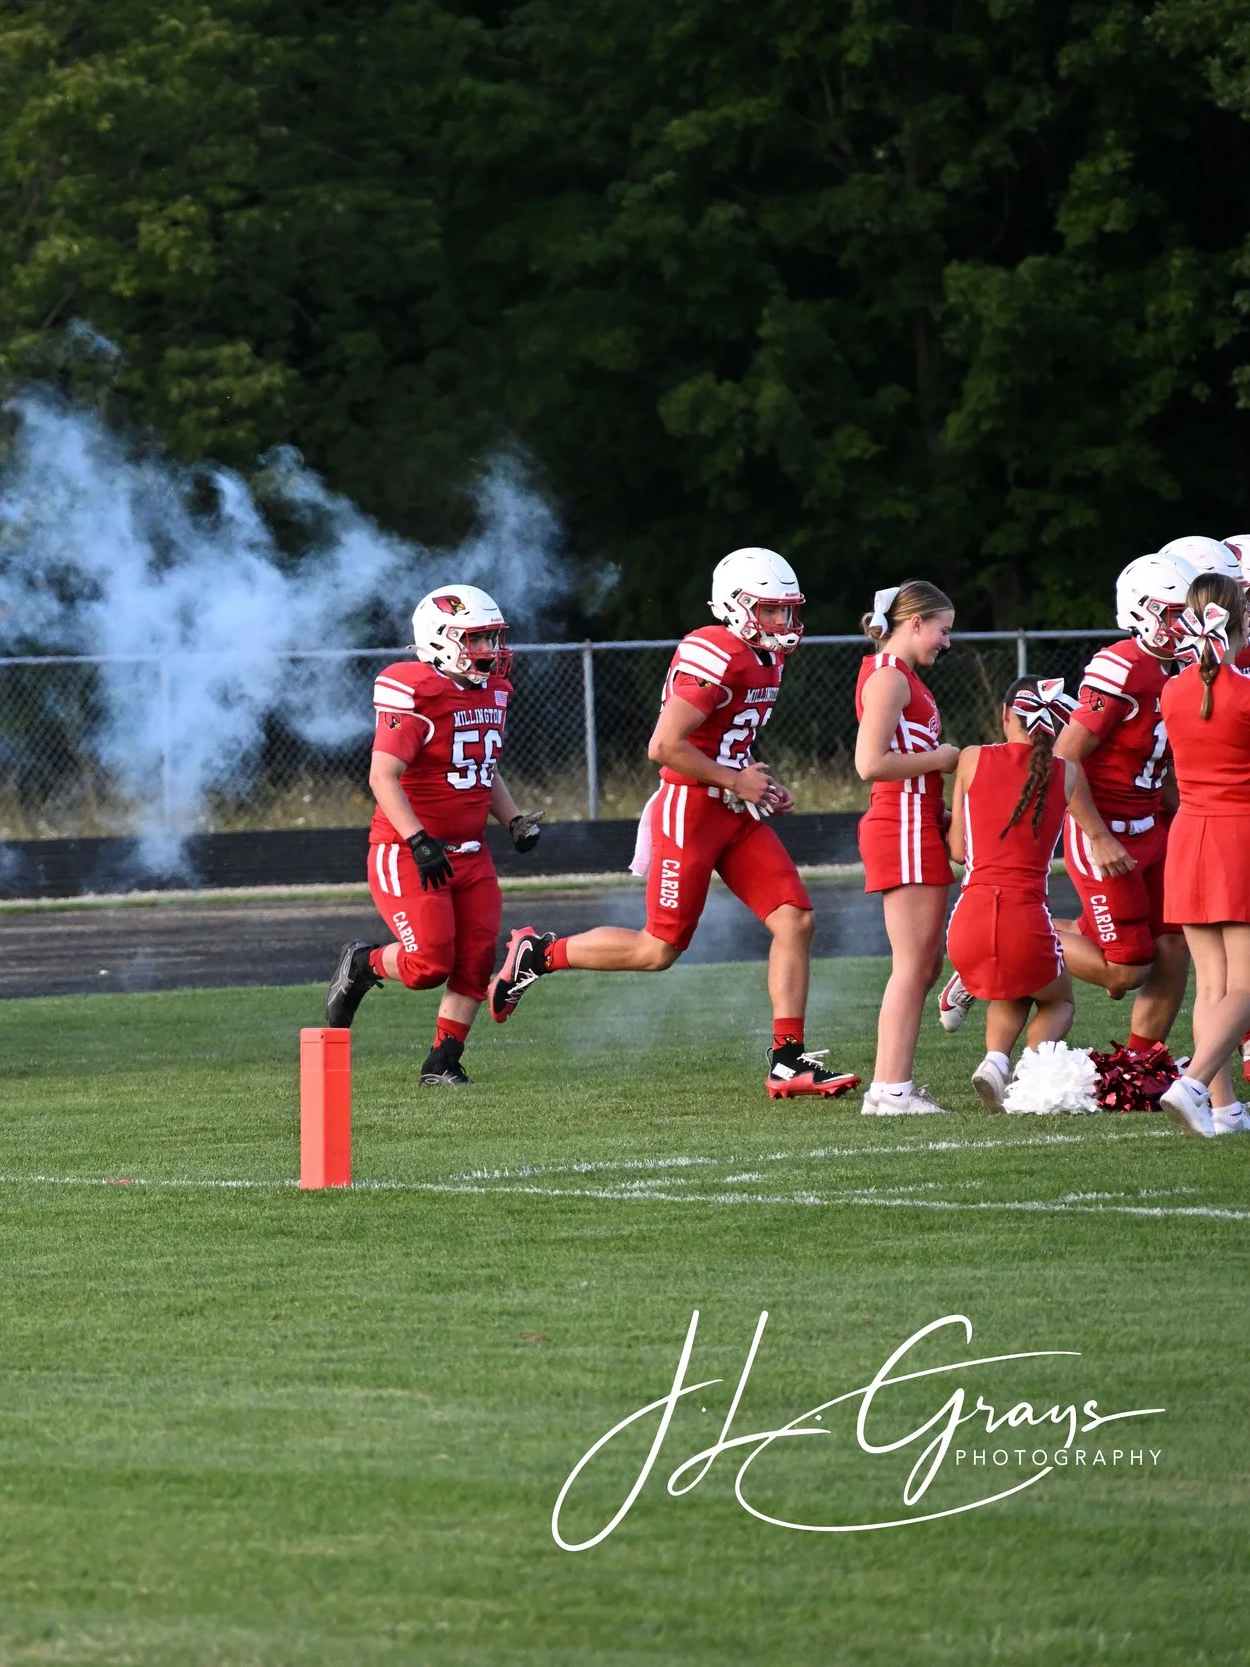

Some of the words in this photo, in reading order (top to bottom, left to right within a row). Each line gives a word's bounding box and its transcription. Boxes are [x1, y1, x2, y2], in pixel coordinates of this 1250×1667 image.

[454, 708, 503, 728] MILLINGTON
[660, 859, 681, 909] CARDS
[392, 911, 419, 953] CARDS
[1090, 894, 1117, 943] CARDS
